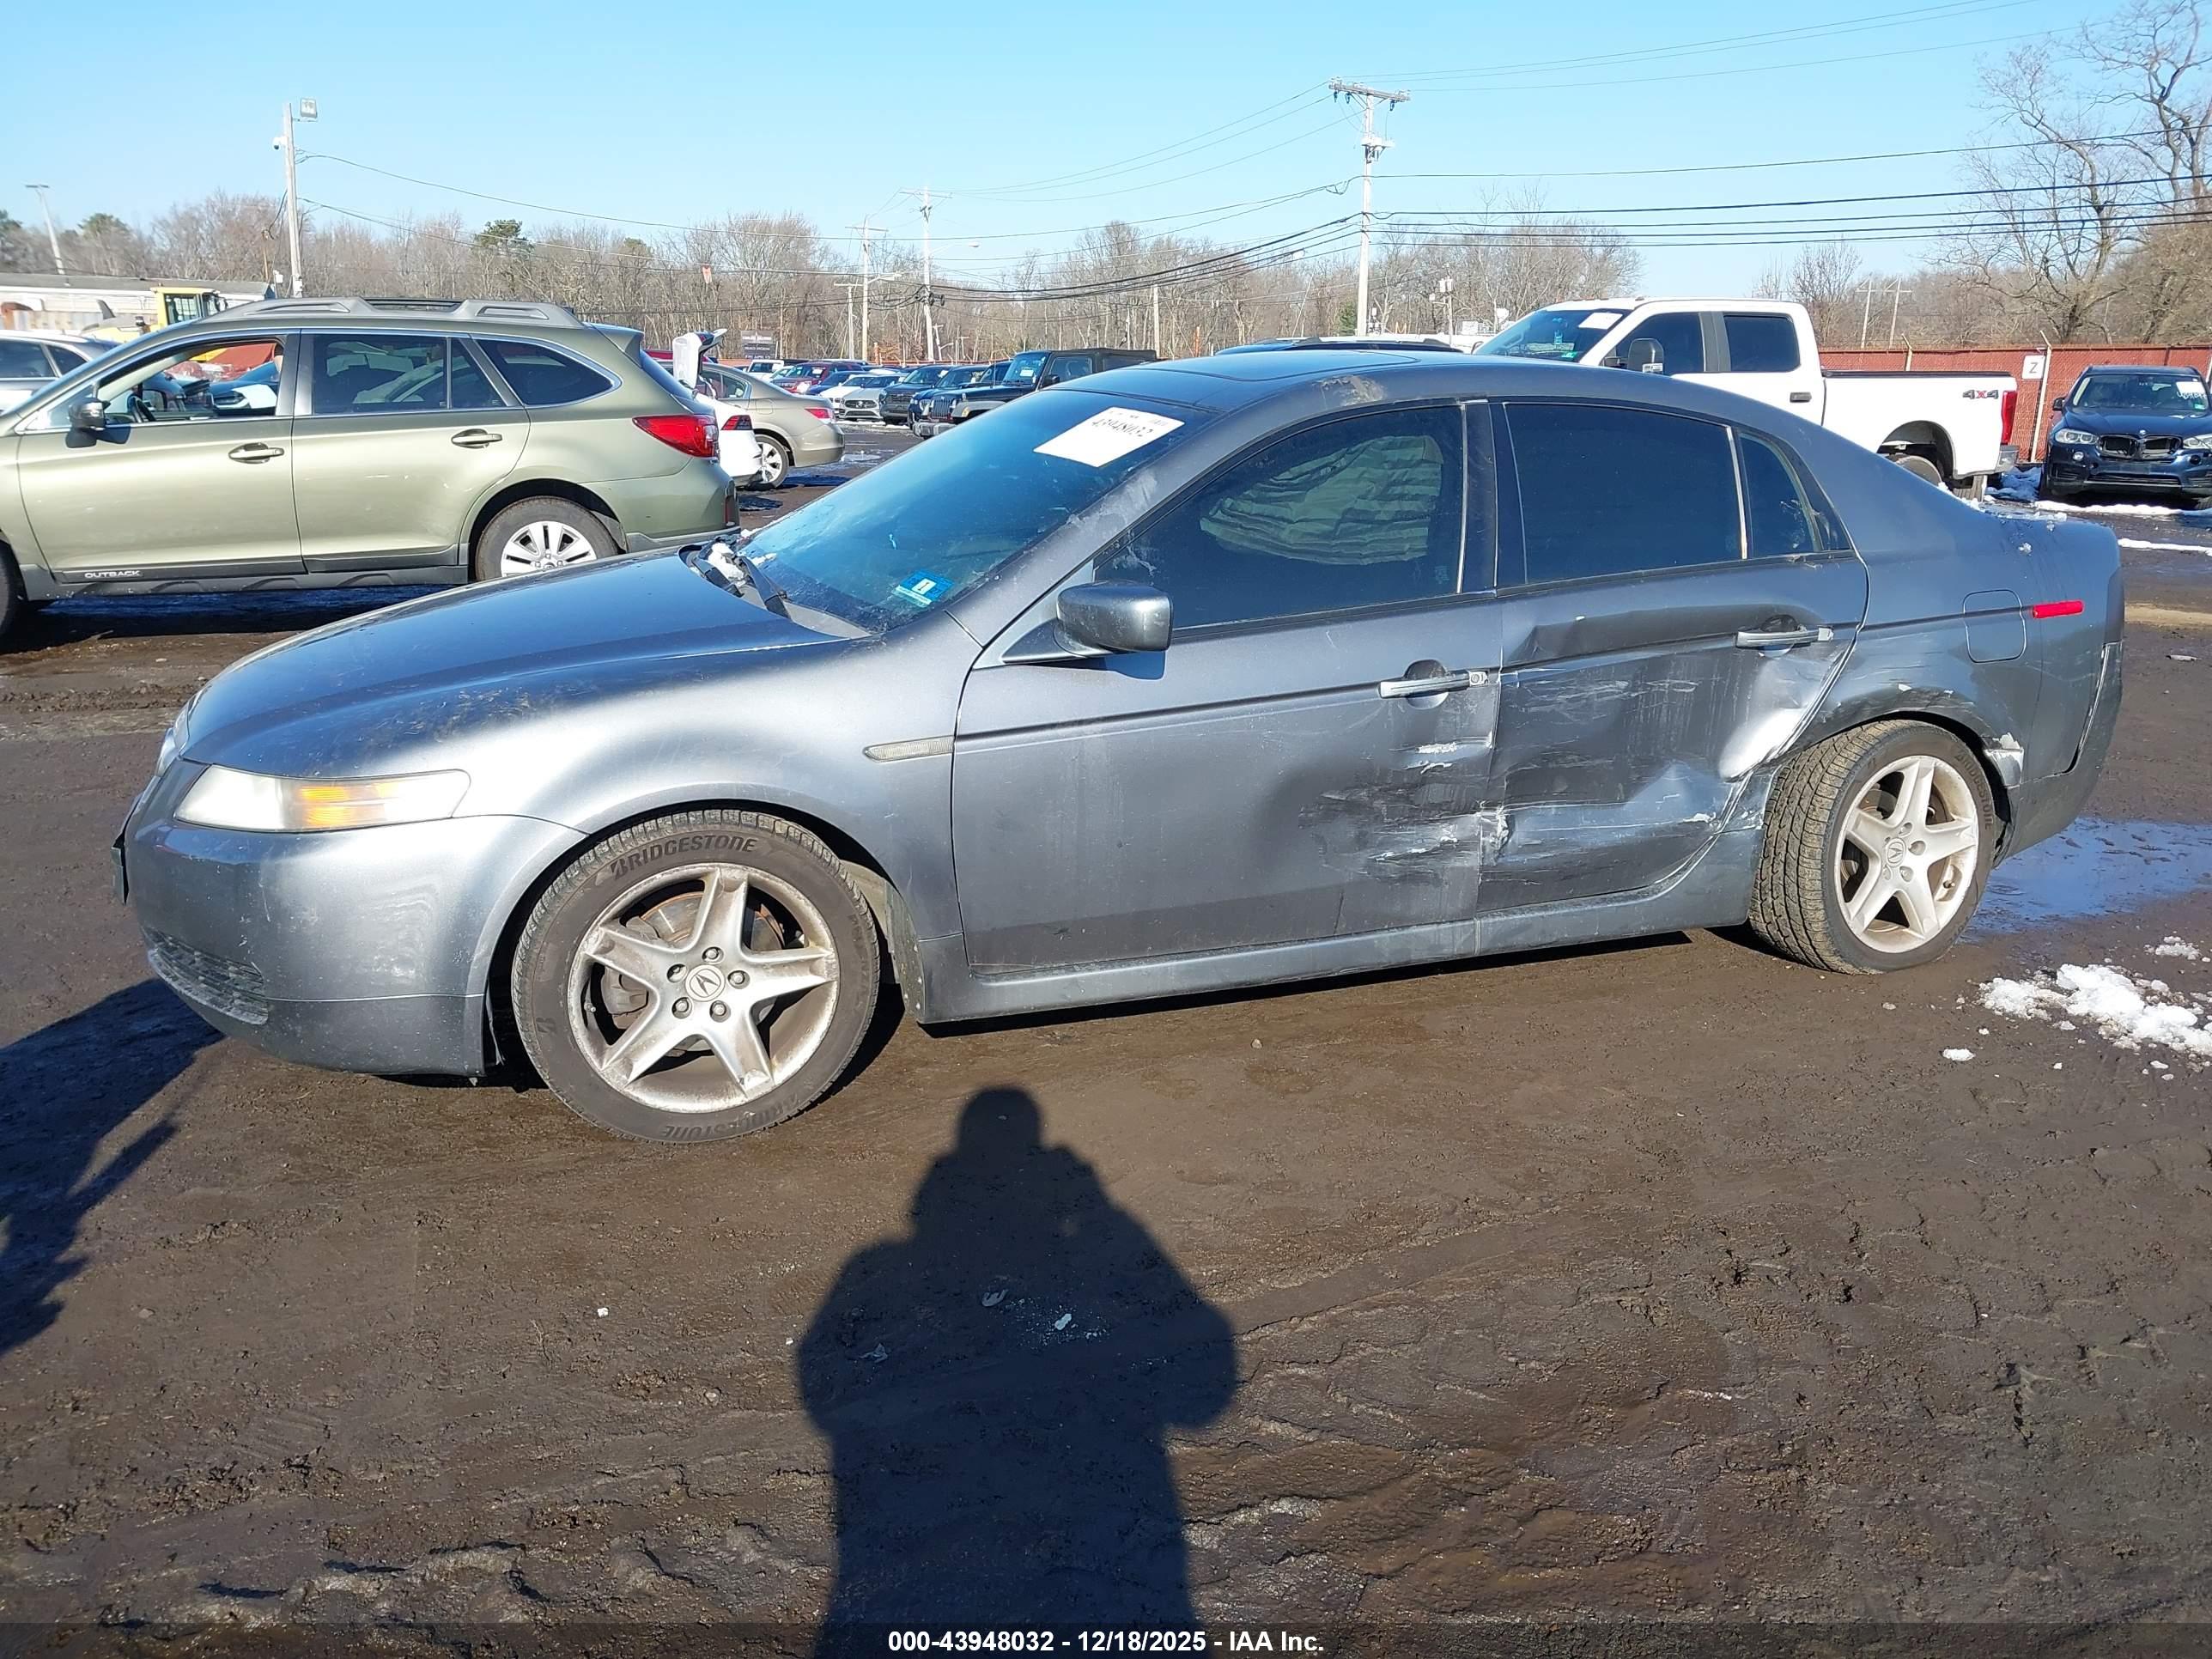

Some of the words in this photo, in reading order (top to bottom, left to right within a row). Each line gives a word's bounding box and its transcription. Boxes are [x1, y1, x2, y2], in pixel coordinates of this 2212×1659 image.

[2028, 362, 2039, 374] Z
[84, 570, 143, 579] OUTBACK
[610, 835, 758, 880] BRIDGESTONE
